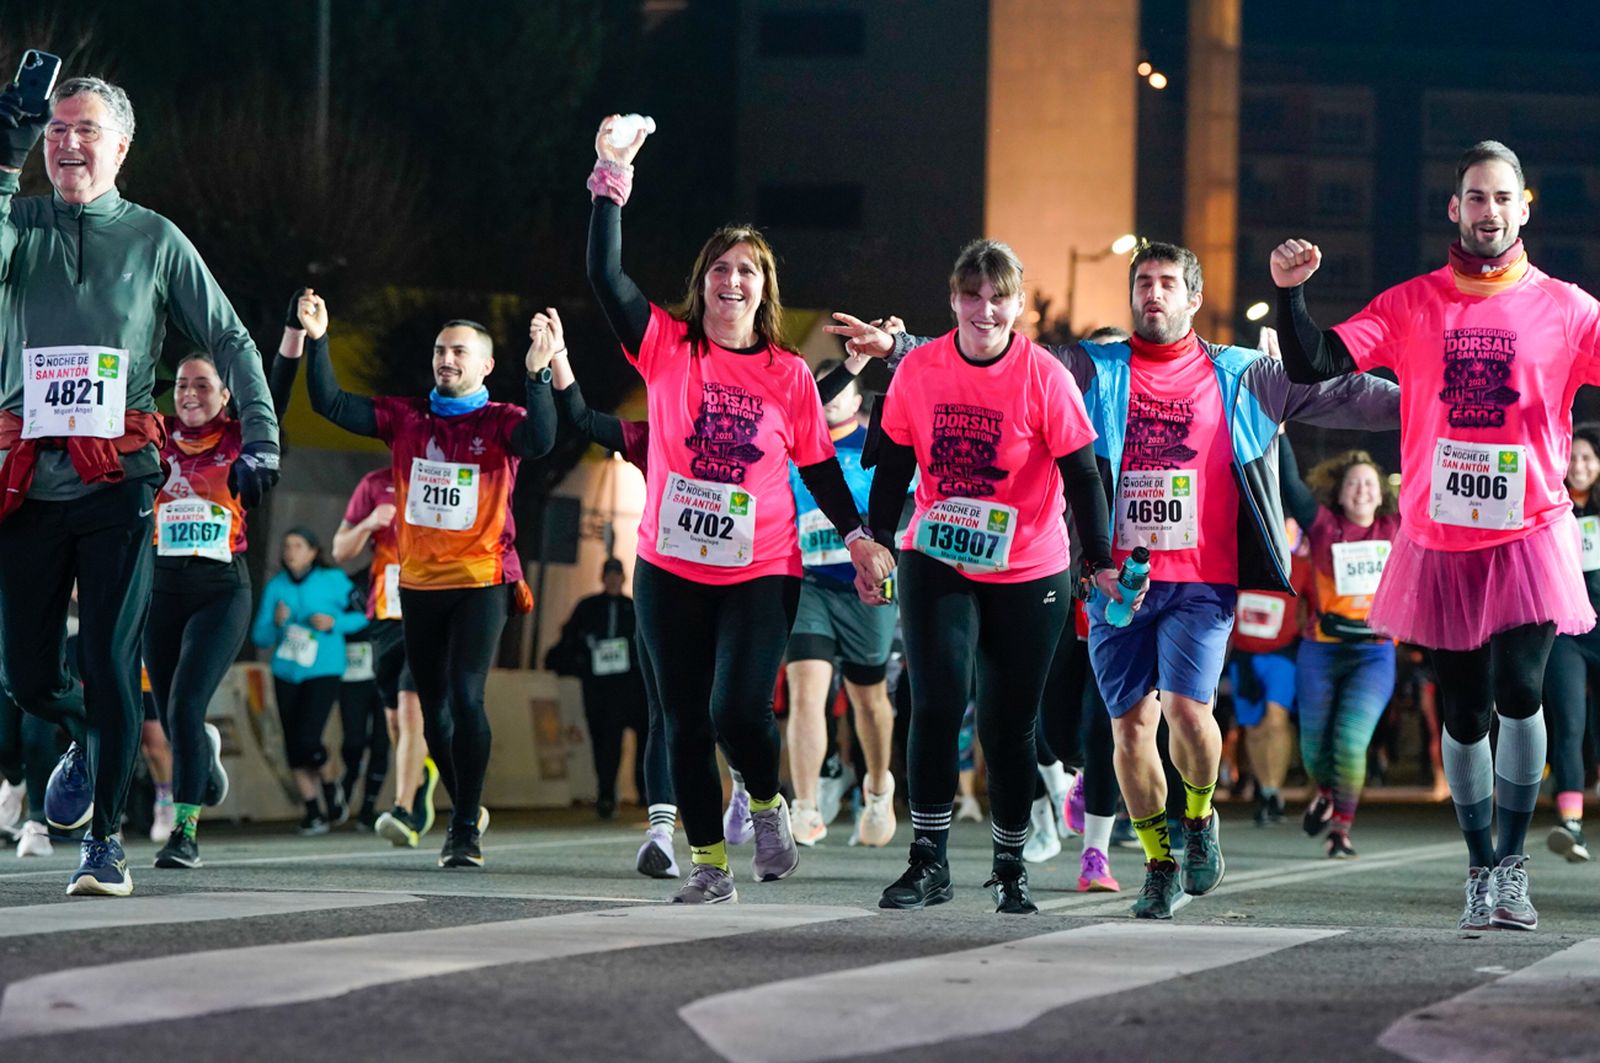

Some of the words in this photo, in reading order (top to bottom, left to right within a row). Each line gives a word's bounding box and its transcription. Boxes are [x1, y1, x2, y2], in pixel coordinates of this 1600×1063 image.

[1458, 328, 1516, 340] CONSEGUIDO
[1446, 336, 1515, 355] DORSAL
[46, 356, 77, 367] NOCHE
[78, 356, 89, 365] DE
[1456, 351, 1475, 360] SAN
[36, 370, 54, 380] SAN
[56, 366, 88, 378] ANTÓN
[44, 378, 104, 406] 4821
[706, 404, 724, 414] SAN
[948, 404, 1003, 420] CONSEGUIDO
[1130, 400, 1193, 417] DORSAL
[935, 414, 1000, 436] DORSAL
[1452, 410, 1502, 426] 500€
[944, 428, 962, 438] SAN
[1452, 450, 1476, 462] NOCHE
[1478, 454, 1490, 462] DE
[694, 459, 743, 483] 500€
[1442, 459, 1458, 470] SAN
[1459, 461, 1490, 473] ANTÓN
[170, 482, 189, 498] 43
[1130, 480, 1152, 488] NOCHE
[1154, 480, 1164, 488] DE
[1446, 472, 1508, 500] 4906
[423, 484, 460, 507] 2116
[686, 486, 712, 499] NOCHE
[712, 492, 722, 502] DE
[1124, 490, 1136, 499] SAN
[1137, 487, 1164, 498] ANTÓN
[672, 494, 690, 506] SAN
[692, 498, 721, 513] ANTÓN
[940, 504, 968, 515] NOCHE
[970, 508, 981, 518] DE
[1126, 500, 1182, 523] 4690
[678, 508, 734, 540] 4702
[928, 511, 947, 523] SAN
[948, 515, 980, 529] ANTÓN
[168, 522, 221, 542] 12667
[928, 523, 1000, 560] 13907
[1347, 560, 1382, 576] 5834
